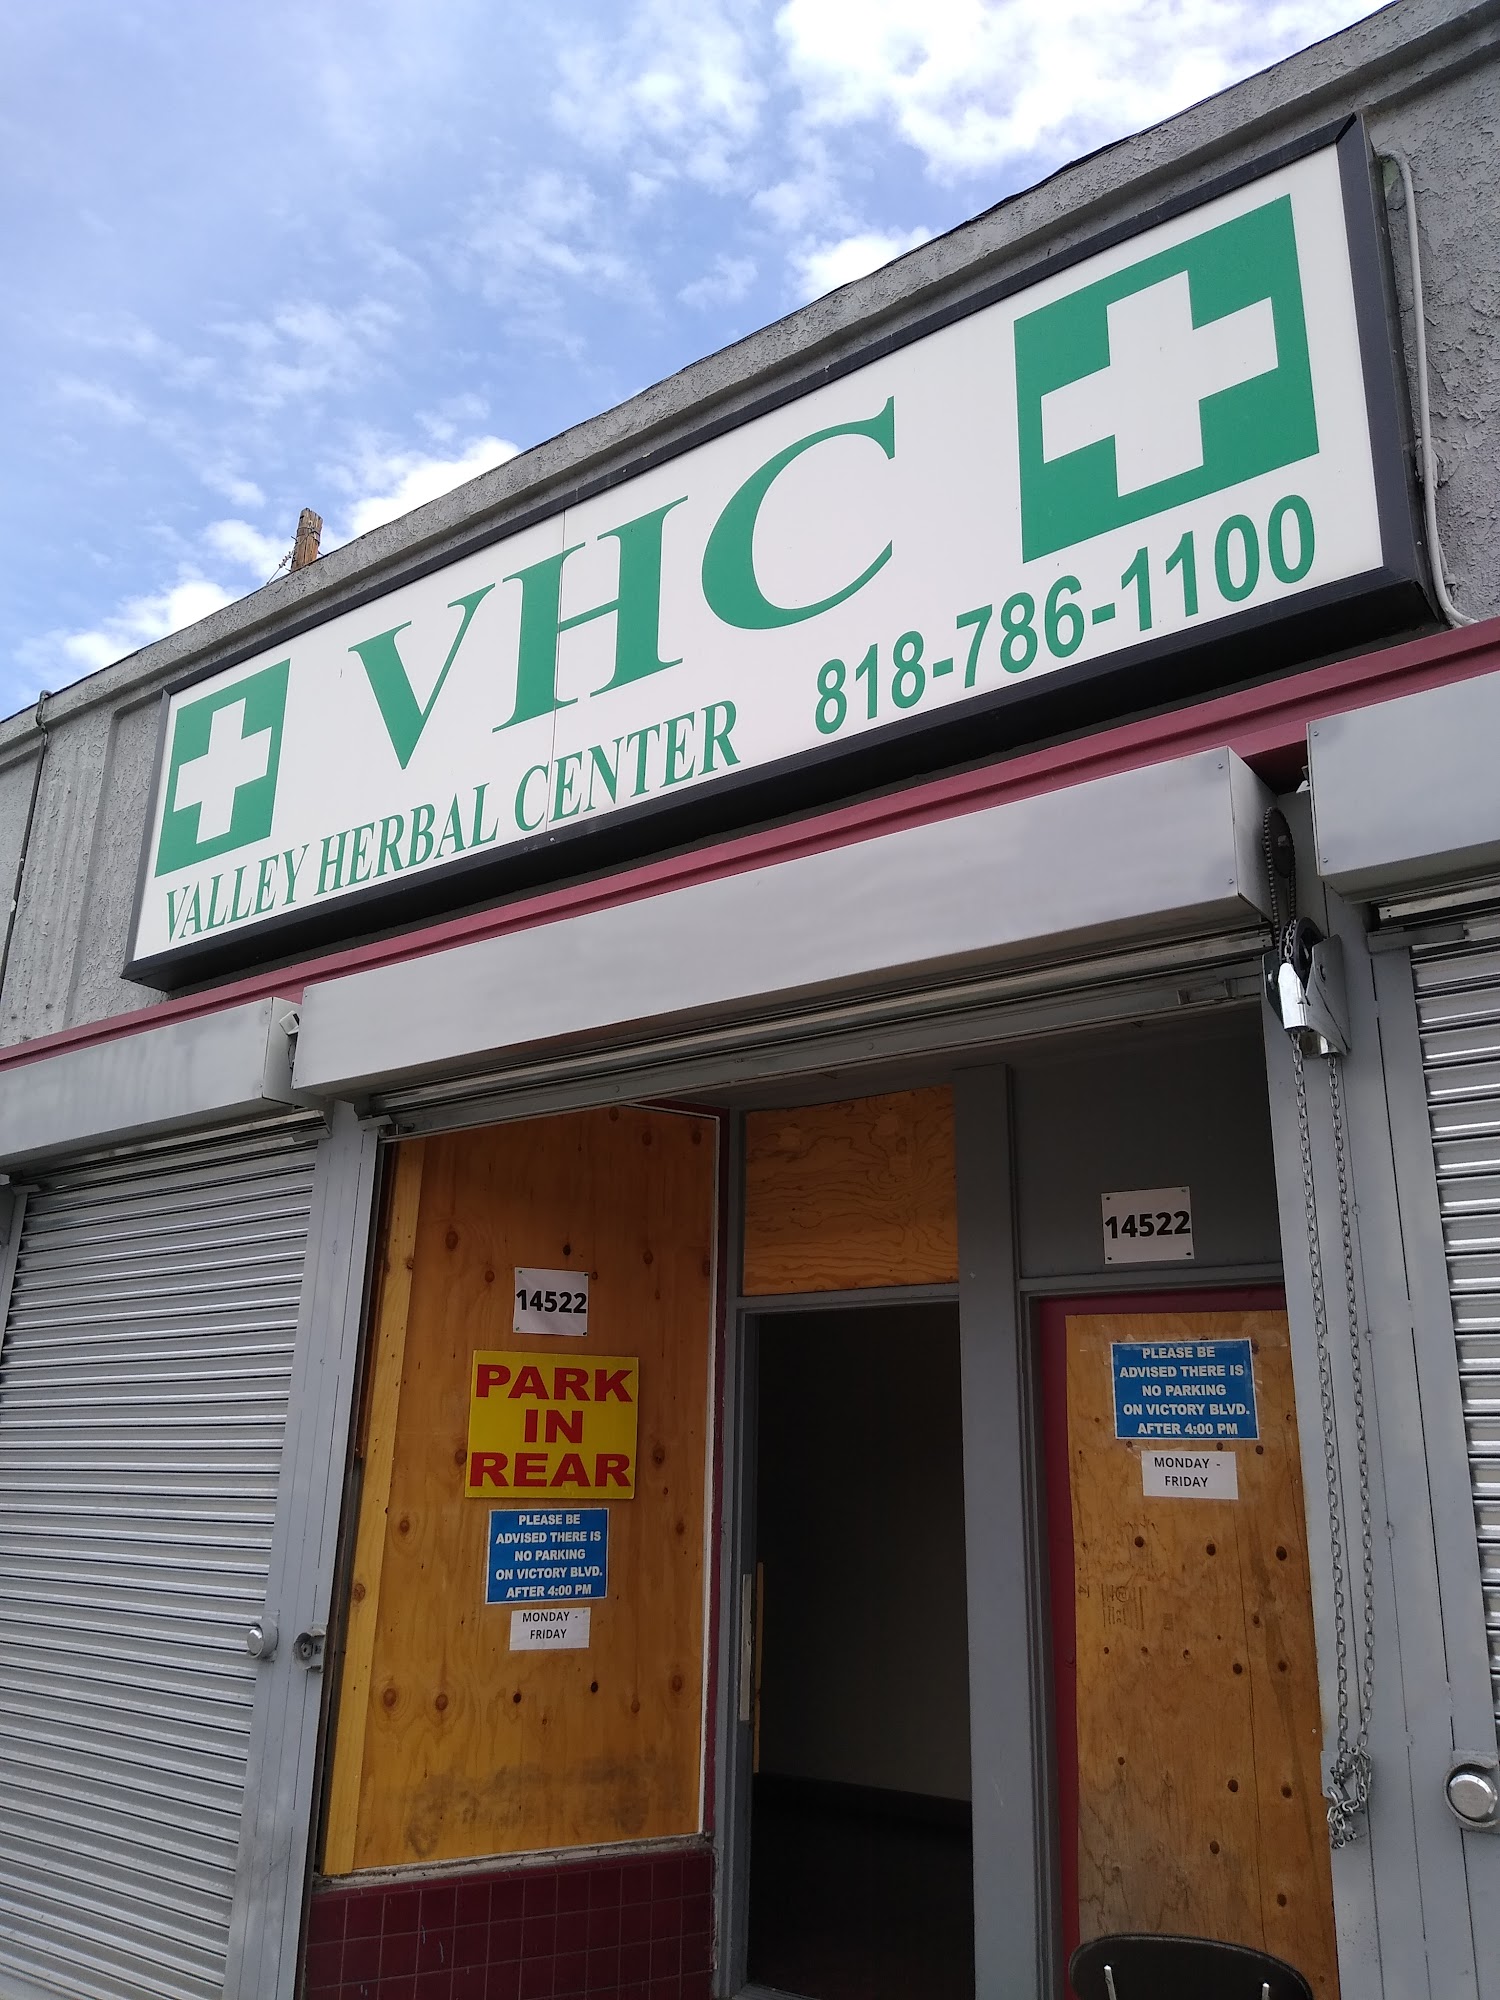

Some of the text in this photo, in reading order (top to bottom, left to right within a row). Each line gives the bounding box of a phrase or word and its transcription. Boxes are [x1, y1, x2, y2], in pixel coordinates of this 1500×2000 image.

[349, 397, 896, 769] VHC
[815, 494, 1315, 735] 818-786-1100
[165, 699, 741, 942] VALLEY HERBAL CENTER
[1105, 1210, 1191, 1240] 14522
[515, 1288, 588, 1315] 14522
[1142, 1346, 1216, 1359] PLEASE BE
[1119, 1364, 1244, 1378] ADVISED THERE IS
[476, 1363, 634, 1402] PARK
[1141, 1383, 1227, 1397] NO PARKING
[1123, 1403, 1250, 1415] ON VICTORY BLVD.
[524, 1409, 584, 1444] IN
[1137, 1422, 1239, 1435] AFTER 4:00 PM
[469, 1452, 631, 1487] REAR
[1153, 1457, 1210, 1469] MONDAY
[1164, 1475, 1209, 1488] FRIDAY
[518, 1513, 581, 1526] PLEASE BE
[495, 1530, 602, 1544] ADVISED THERE IS
[514, 1548, 586, 1562] NO PARKING
[495, 1565, 603, 1580] ON VICTORY BLVD.
[506, 1583, 592, 1598] AFTER 4:00 PM
[522, 1611, 570, 1623] MONDAY
[529, 1628, 567, 1640] FRIDAY
